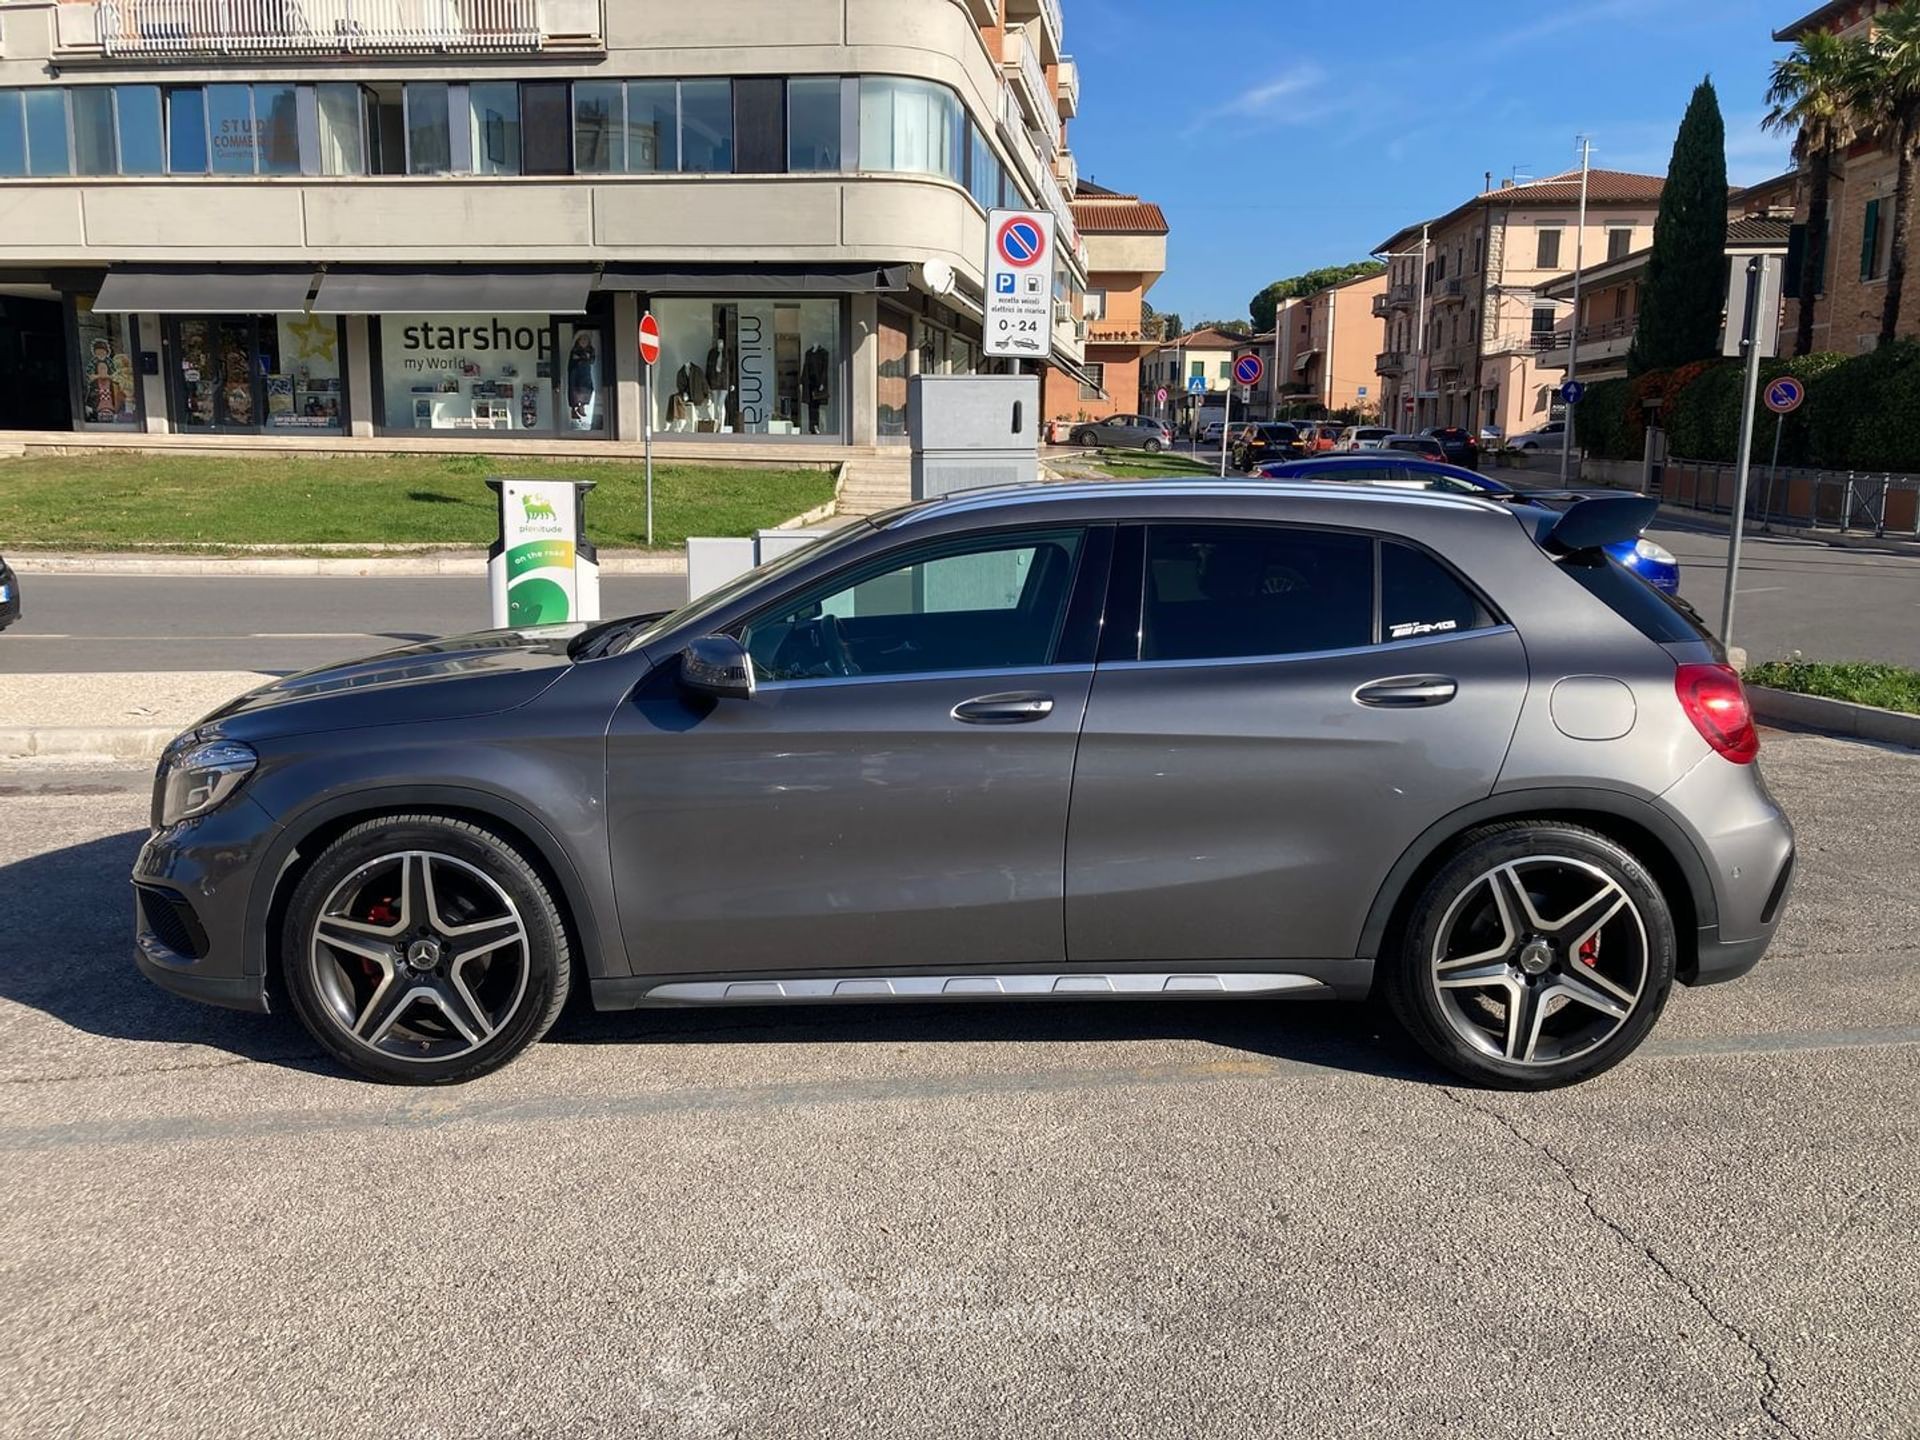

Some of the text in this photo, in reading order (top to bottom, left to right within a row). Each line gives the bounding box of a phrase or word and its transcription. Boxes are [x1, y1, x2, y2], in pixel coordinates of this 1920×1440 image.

[222, 119, 272, 133] STUD
[999, 275, 1012, 292] P
[999, 319, 1008, 331] 0
[1019, 320, 1037, 332] 24
[403, 317, 551, 361] starshop
[404, 357, 466, 371] my World
[519, 524, 563, 534] plenitude
[515, 556, 526, 565] on
[527, 551, 543, 560] the
